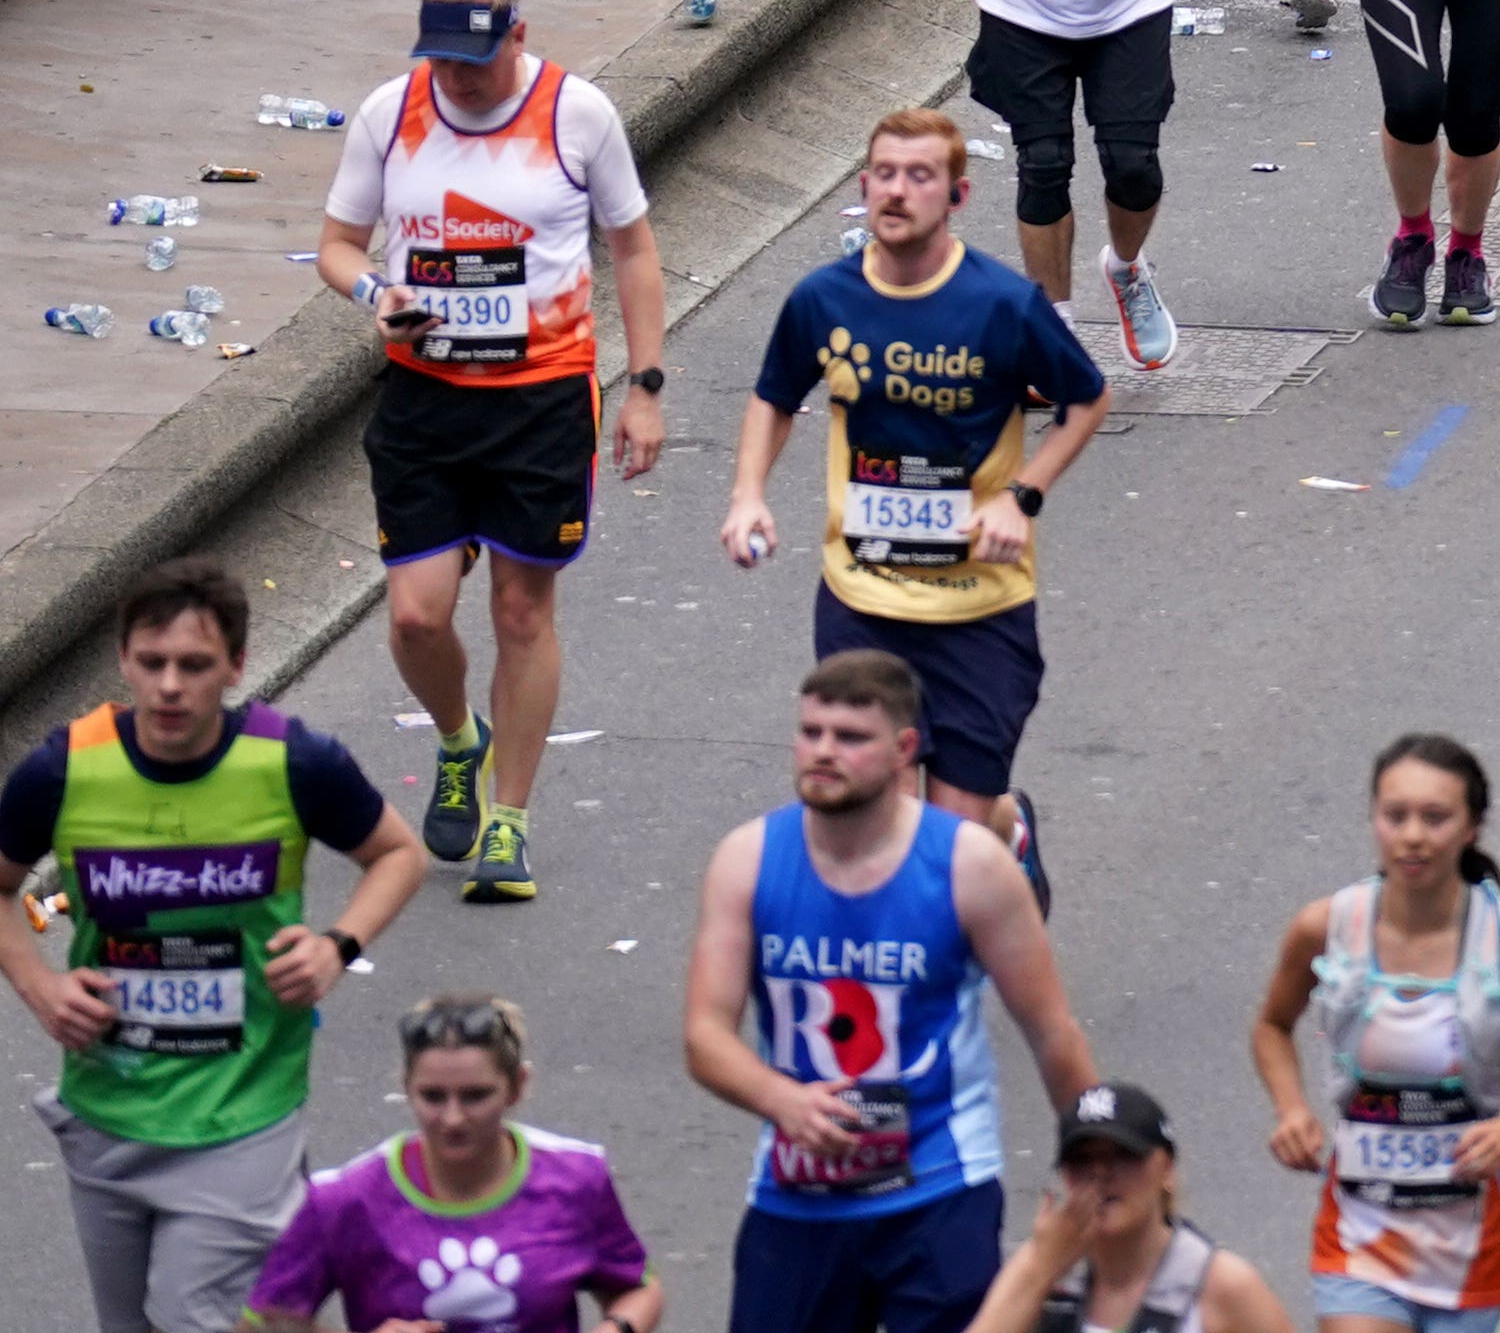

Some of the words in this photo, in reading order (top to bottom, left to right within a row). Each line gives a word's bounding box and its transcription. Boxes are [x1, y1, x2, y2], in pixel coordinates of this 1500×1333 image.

[400, 213, 438, 241] MS
[445, 215, 521, 245] Society
[421, 295, 511, 325] 11390
[885, 339, 986, 375] Guide
[885, 373, 975, 414] Dogs
[860, 497, 954, 530] 15343
[761, 933, 928, 981] PALMER
[116, 978, 224, 1014] 14384
